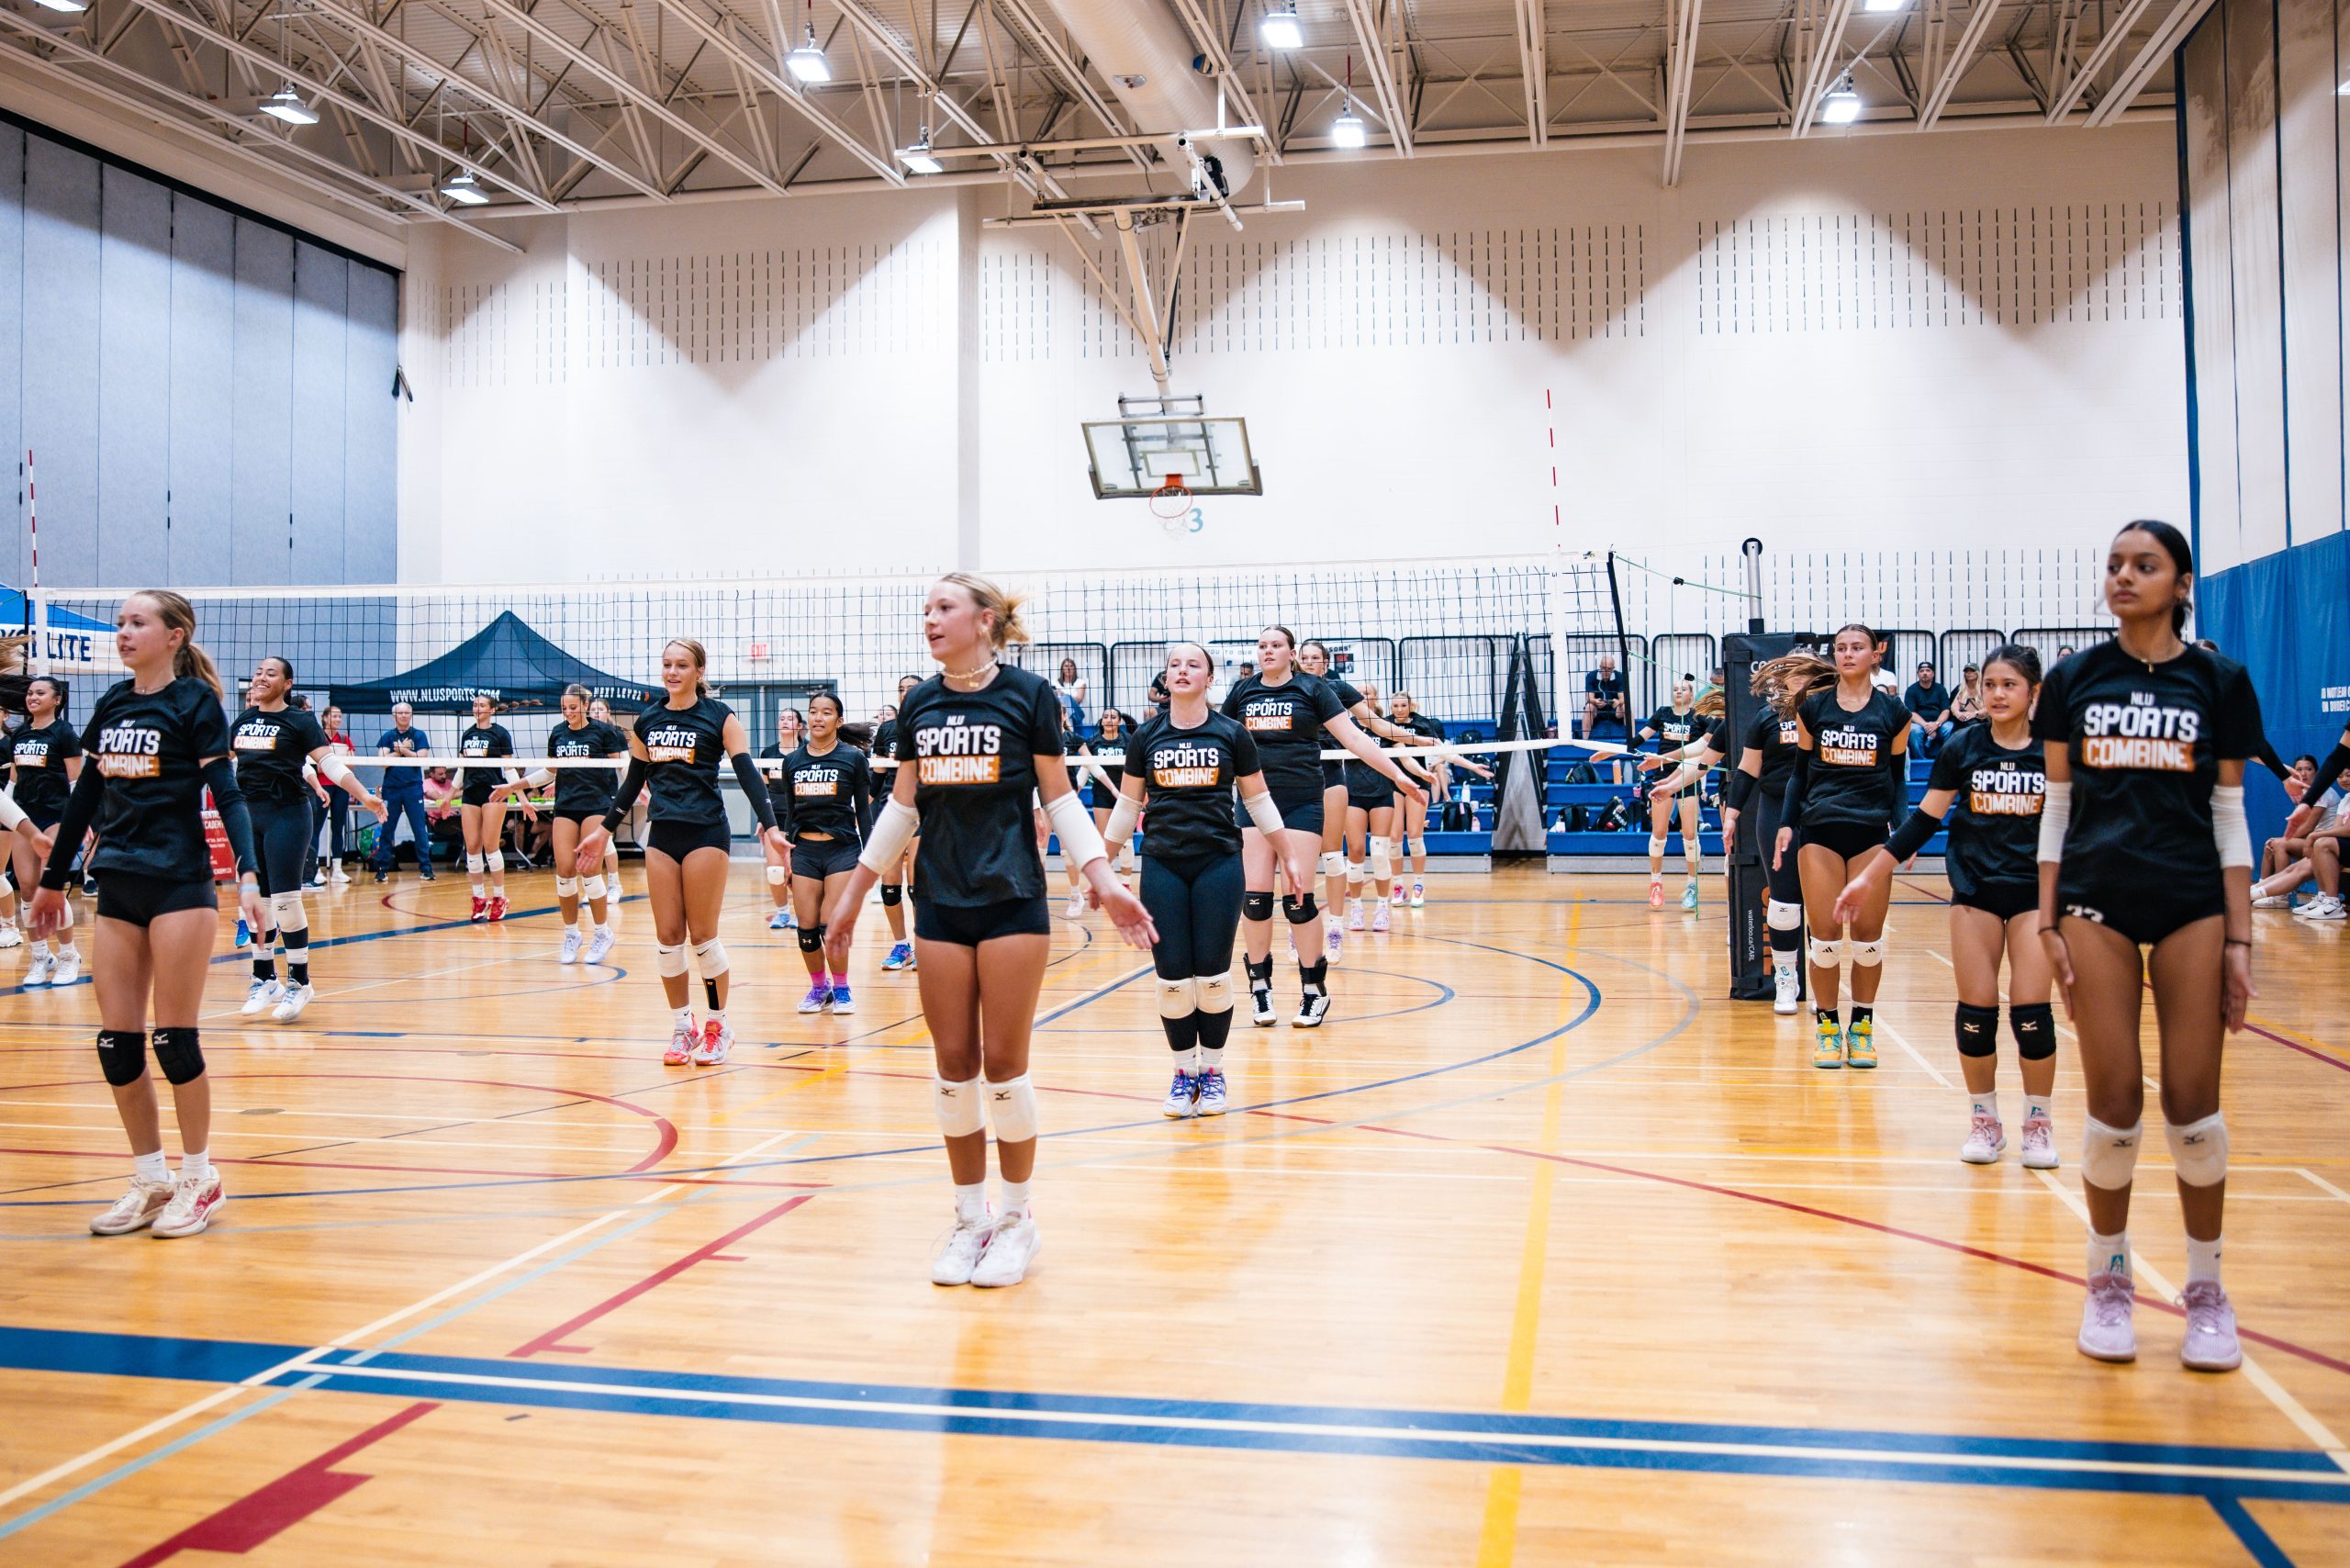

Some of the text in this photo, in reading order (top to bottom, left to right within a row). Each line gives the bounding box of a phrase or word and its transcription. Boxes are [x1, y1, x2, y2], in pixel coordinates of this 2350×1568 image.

[1190, 508, 1203, 532] 3
[2130, 690, 2154, 706] NLU
[1246, 702, 1292, 717] SPORTS
[946, 715, 965, 725] NLU
[1247, 716, 1290, 731] COMBINE
[1843, 724, 1855, 733] NLU
[2084, 702, 2199, 743] SPORTS
[237, 723, 281, 736] SPORTS
[647, 731, 697, 748] SPORTS
[916, 724, 1002, 756] SPORTS
[1820, 729, 1877, 750] SPORTS
[14, 743, 49, 756] SPORTS
[556, 745, 589, 757] SPORTS
[648, 746, 691, 764] COMBINE
[1154, 747, 1219, 769] SPORTS
[1821, 746, 1874, 766] COMBINE
[2087, 737, 2189, 769] COMBINE
[921, 756, 995, 782] COMBINE
[2000, 761, 2016, 771] NLU
[793, 769, 839, 784] SPORTS
[1156, 767, 1216, 787] COMBINE
[1971, 770, 2045, 794] SPORTS
[794, 782, 834, 796] COMBINE
[1973, 792, 2040, 814] COMBINE
